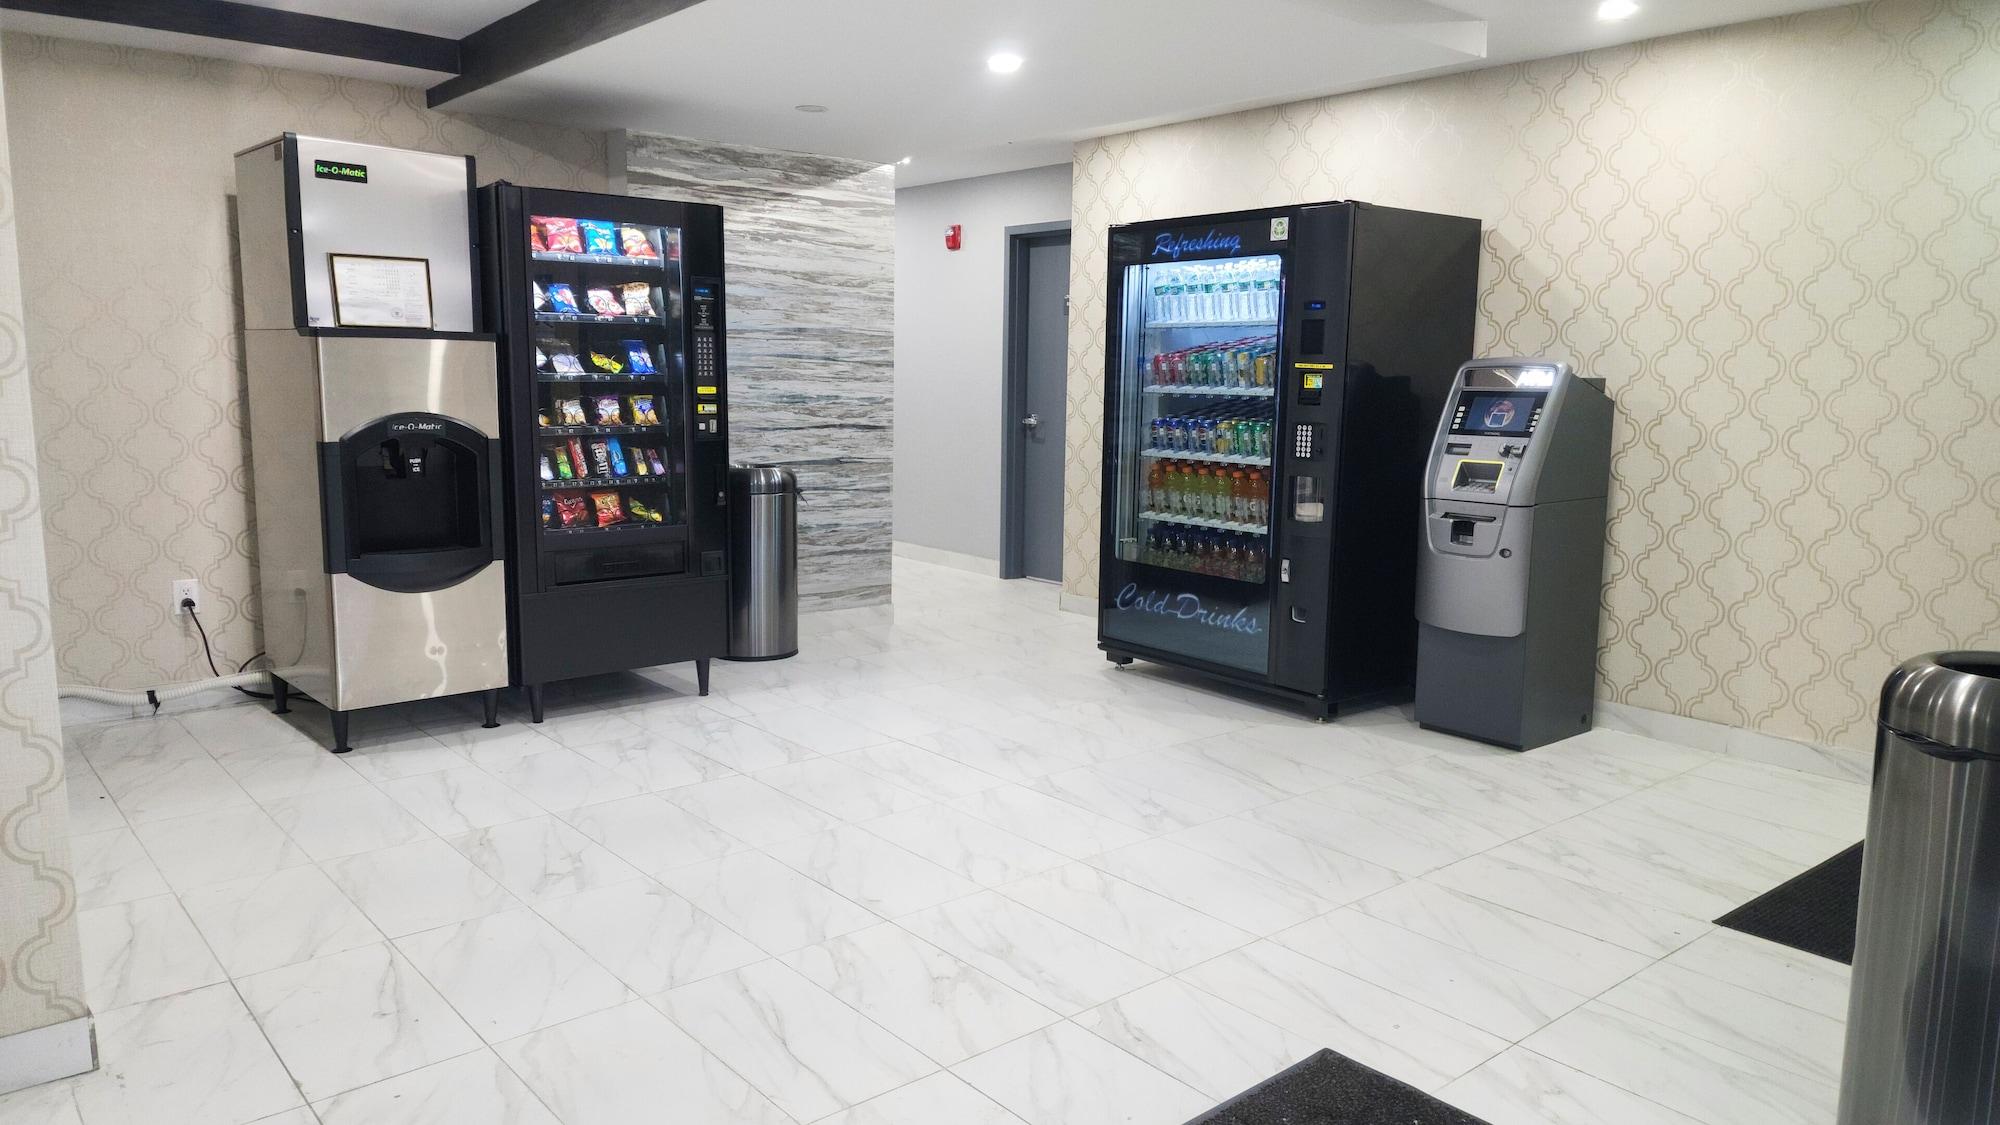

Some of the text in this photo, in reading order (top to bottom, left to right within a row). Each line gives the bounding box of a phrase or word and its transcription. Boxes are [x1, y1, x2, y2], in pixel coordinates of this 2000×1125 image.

[316, 164, 366, 178] Ice-O-Matic
[1152, 229, 1241, 259] Refreshing
[391, 422, 443, 431] Ice-O-Matic
[1115, 582, 1263, 634] Cold Drinks
